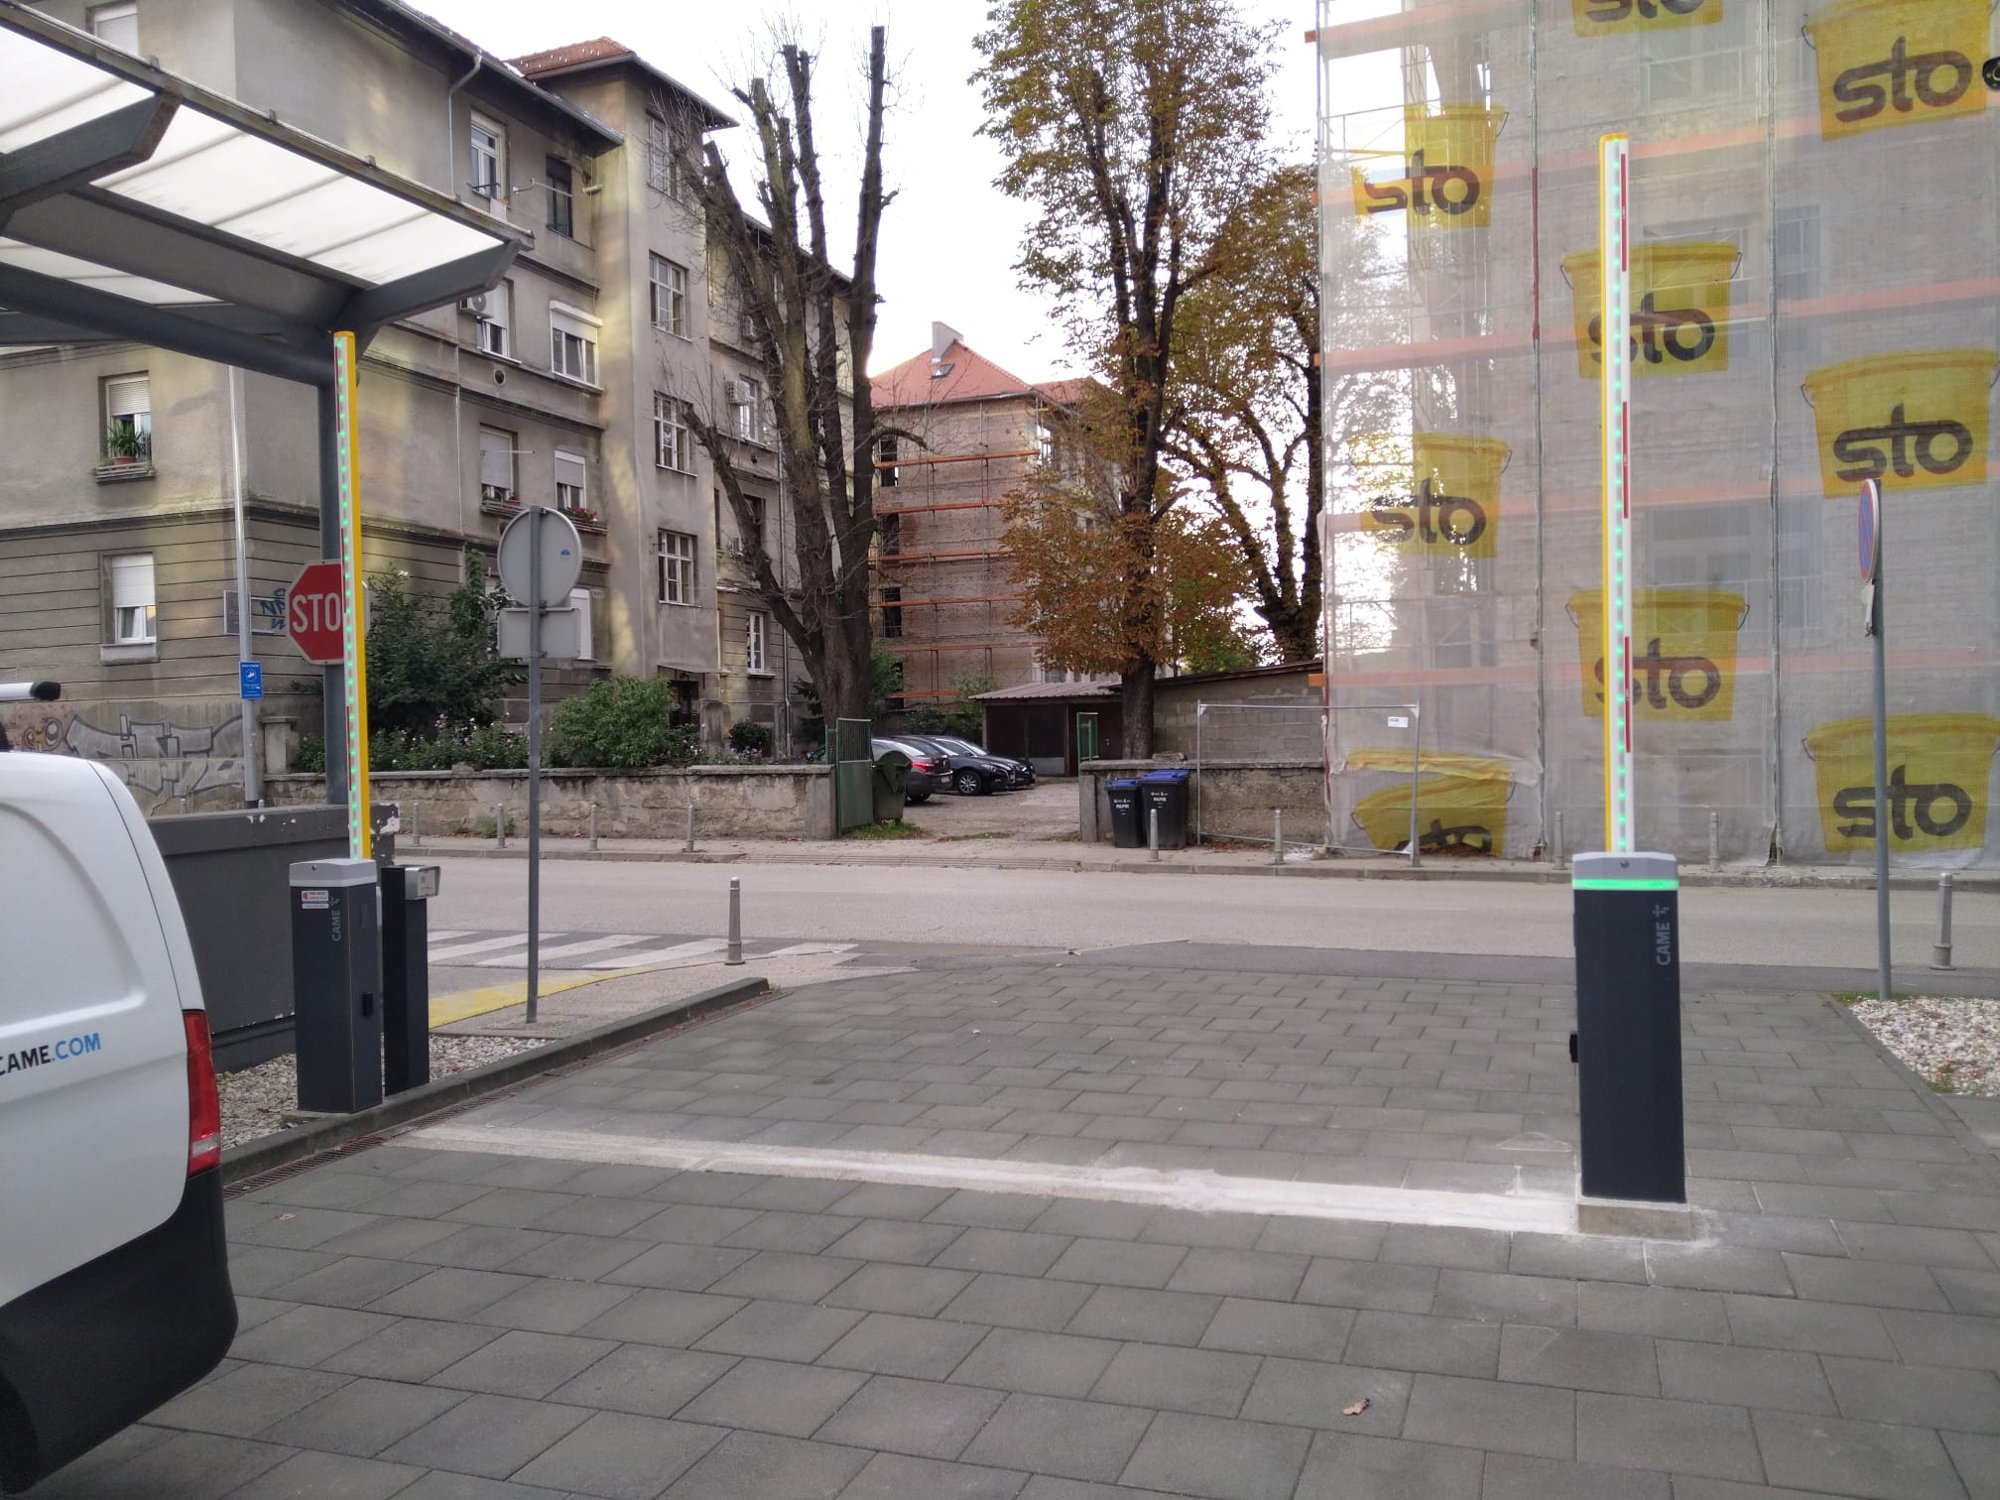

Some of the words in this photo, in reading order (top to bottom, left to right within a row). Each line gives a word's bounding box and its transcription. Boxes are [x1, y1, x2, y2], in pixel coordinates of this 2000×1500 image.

[1833, 36, 1973, 122] sto
[1363, 149, 1480, 215] sto
[1833, 403, 1973, 482] sto
[1371, 477, 1486, 545] sto
[292, 592, 341, 633] STO
[1833, 765, 1973, 840] sto
[331, 909, 342, 942] CAME
[1656, 922, 1671, 966] CAME
